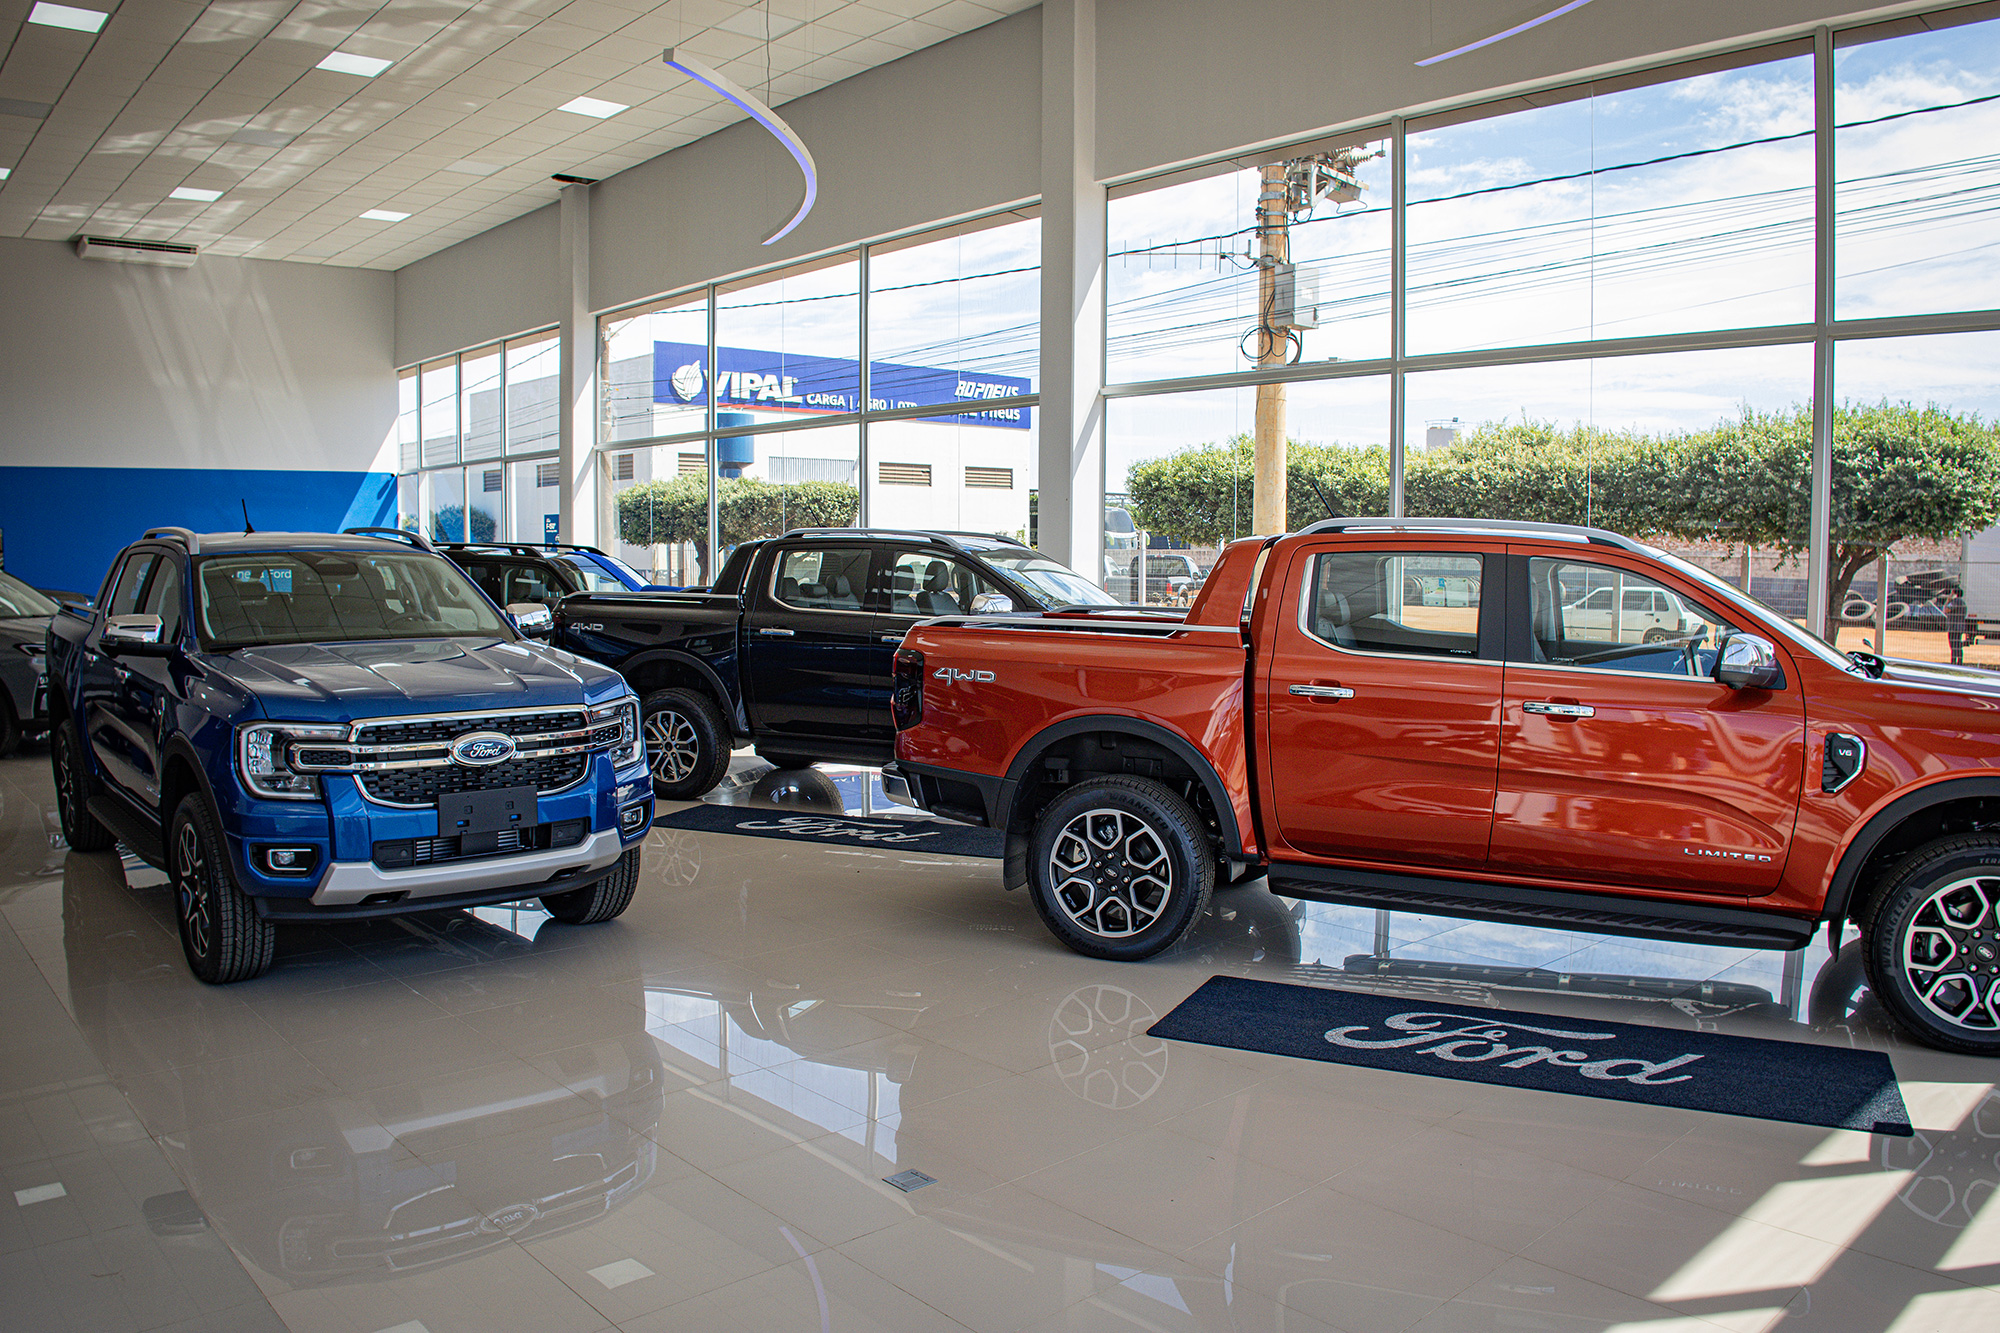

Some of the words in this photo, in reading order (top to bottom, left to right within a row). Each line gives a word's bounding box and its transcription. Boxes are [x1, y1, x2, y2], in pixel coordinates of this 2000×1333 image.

[703, 370, 803, 404] VIPAL
[806, 393, 846, 407] CARGA
[570, 622, 604, 635] 4WD
[932, 667, 996, 686] 4WD
[470, 742, 502, 758] Ford
[1838, 748, 1853, 757] V6
[735, 816, 941, 843] Ford
[1684, 847, 1772, 863] LIMITED
[1881, 890, 1914, 969] WRANGLER
[1323, 1011, 1705, 1086] Ford
